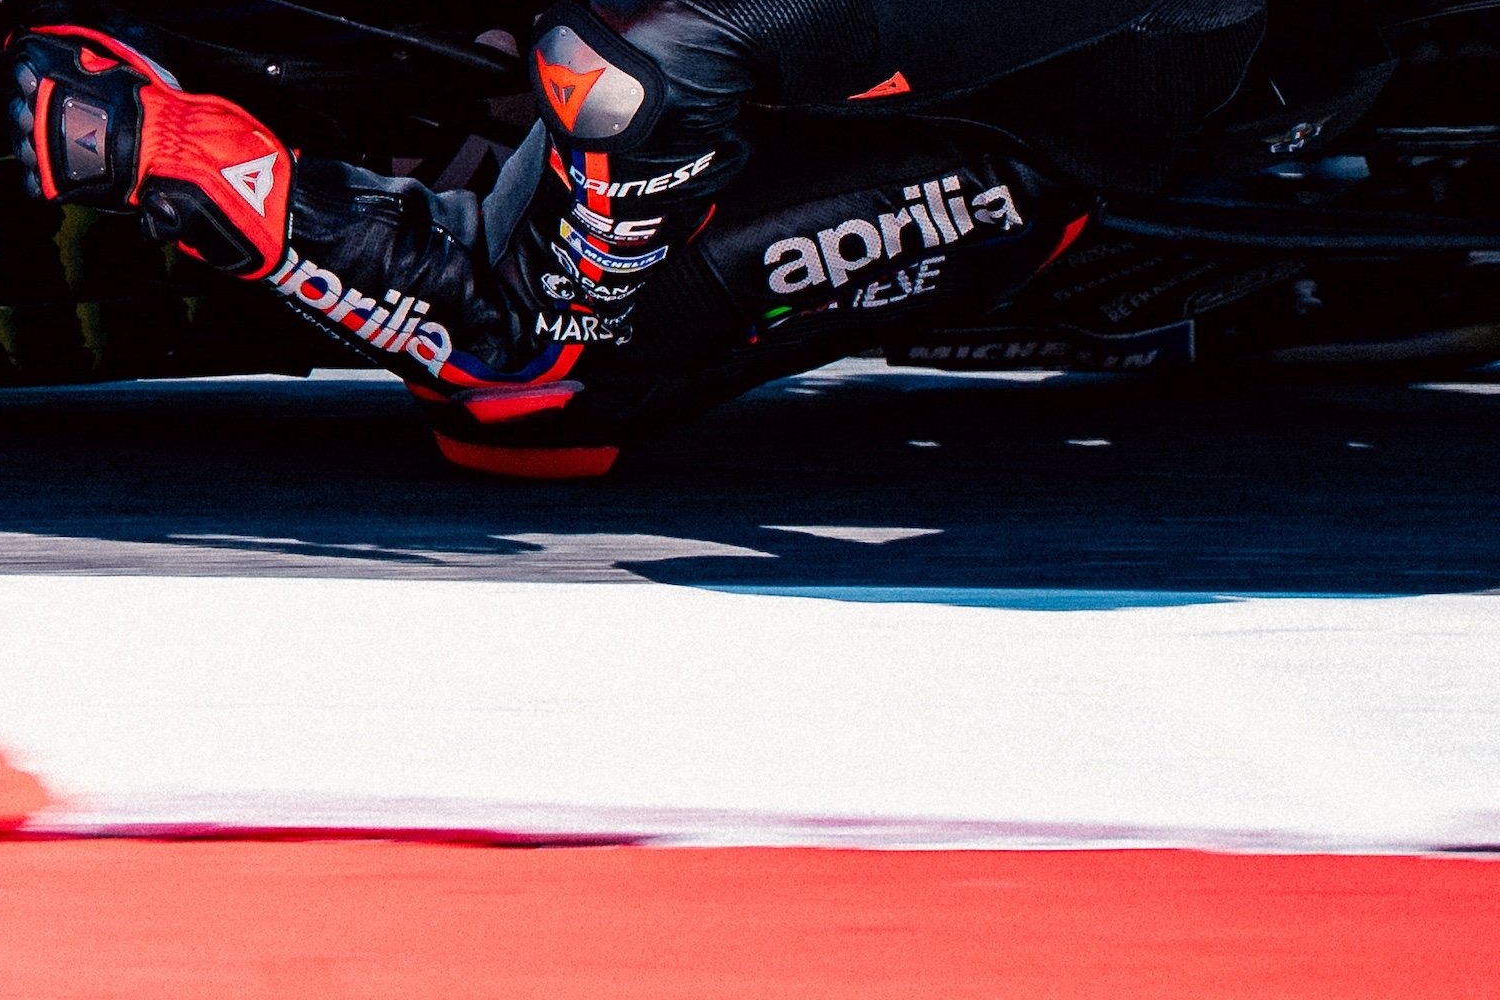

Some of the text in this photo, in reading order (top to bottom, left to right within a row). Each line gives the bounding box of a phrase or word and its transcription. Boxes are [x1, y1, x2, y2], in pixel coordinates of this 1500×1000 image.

[569, 151, 717, 198] DAINESE
[763, 175, 1025, 295] aprilia
[583, 248, 657, 270] MICHELIN
